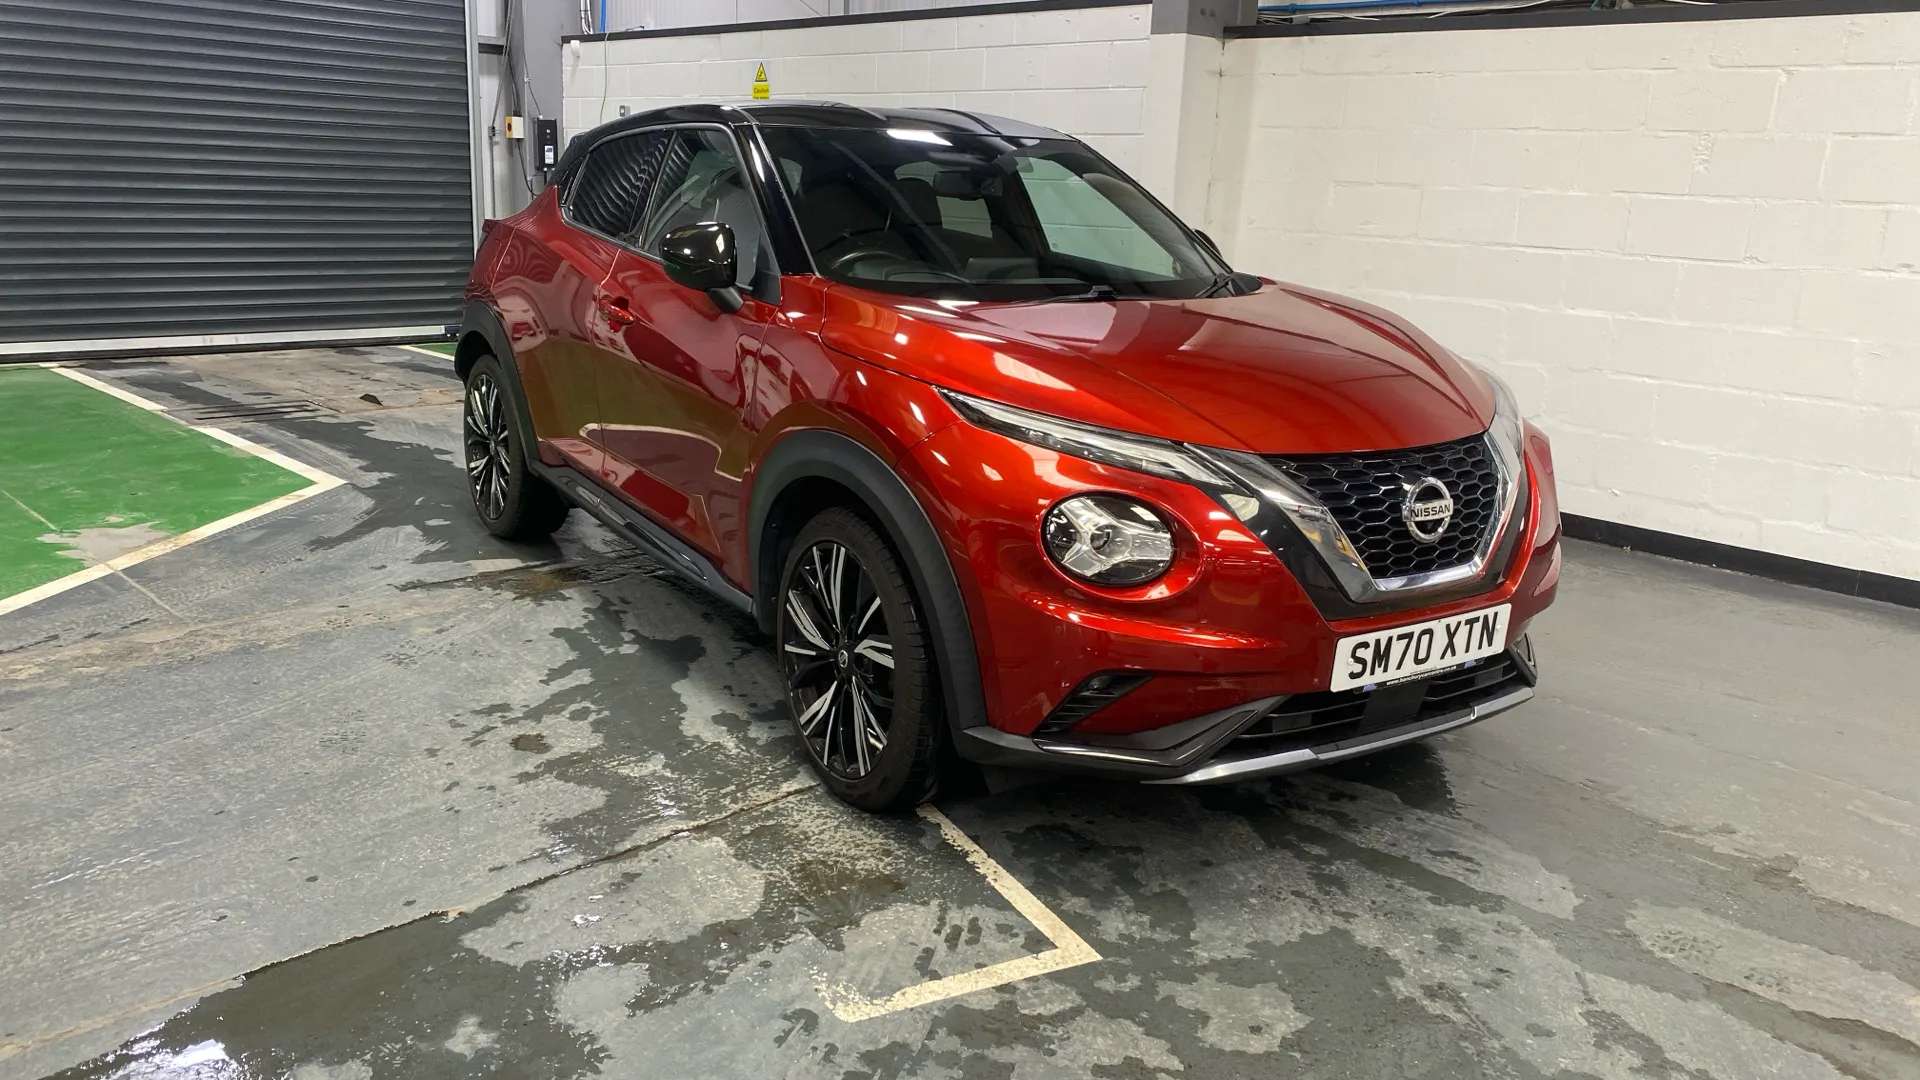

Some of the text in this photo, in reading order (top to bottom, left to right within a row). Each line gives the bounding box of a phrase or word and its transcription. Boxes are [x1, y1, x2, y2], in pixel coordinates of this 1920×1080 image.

[1410, 503, 1450, 518] NISSAN
[1348, 611, 1499, 680] SM70 XTN
